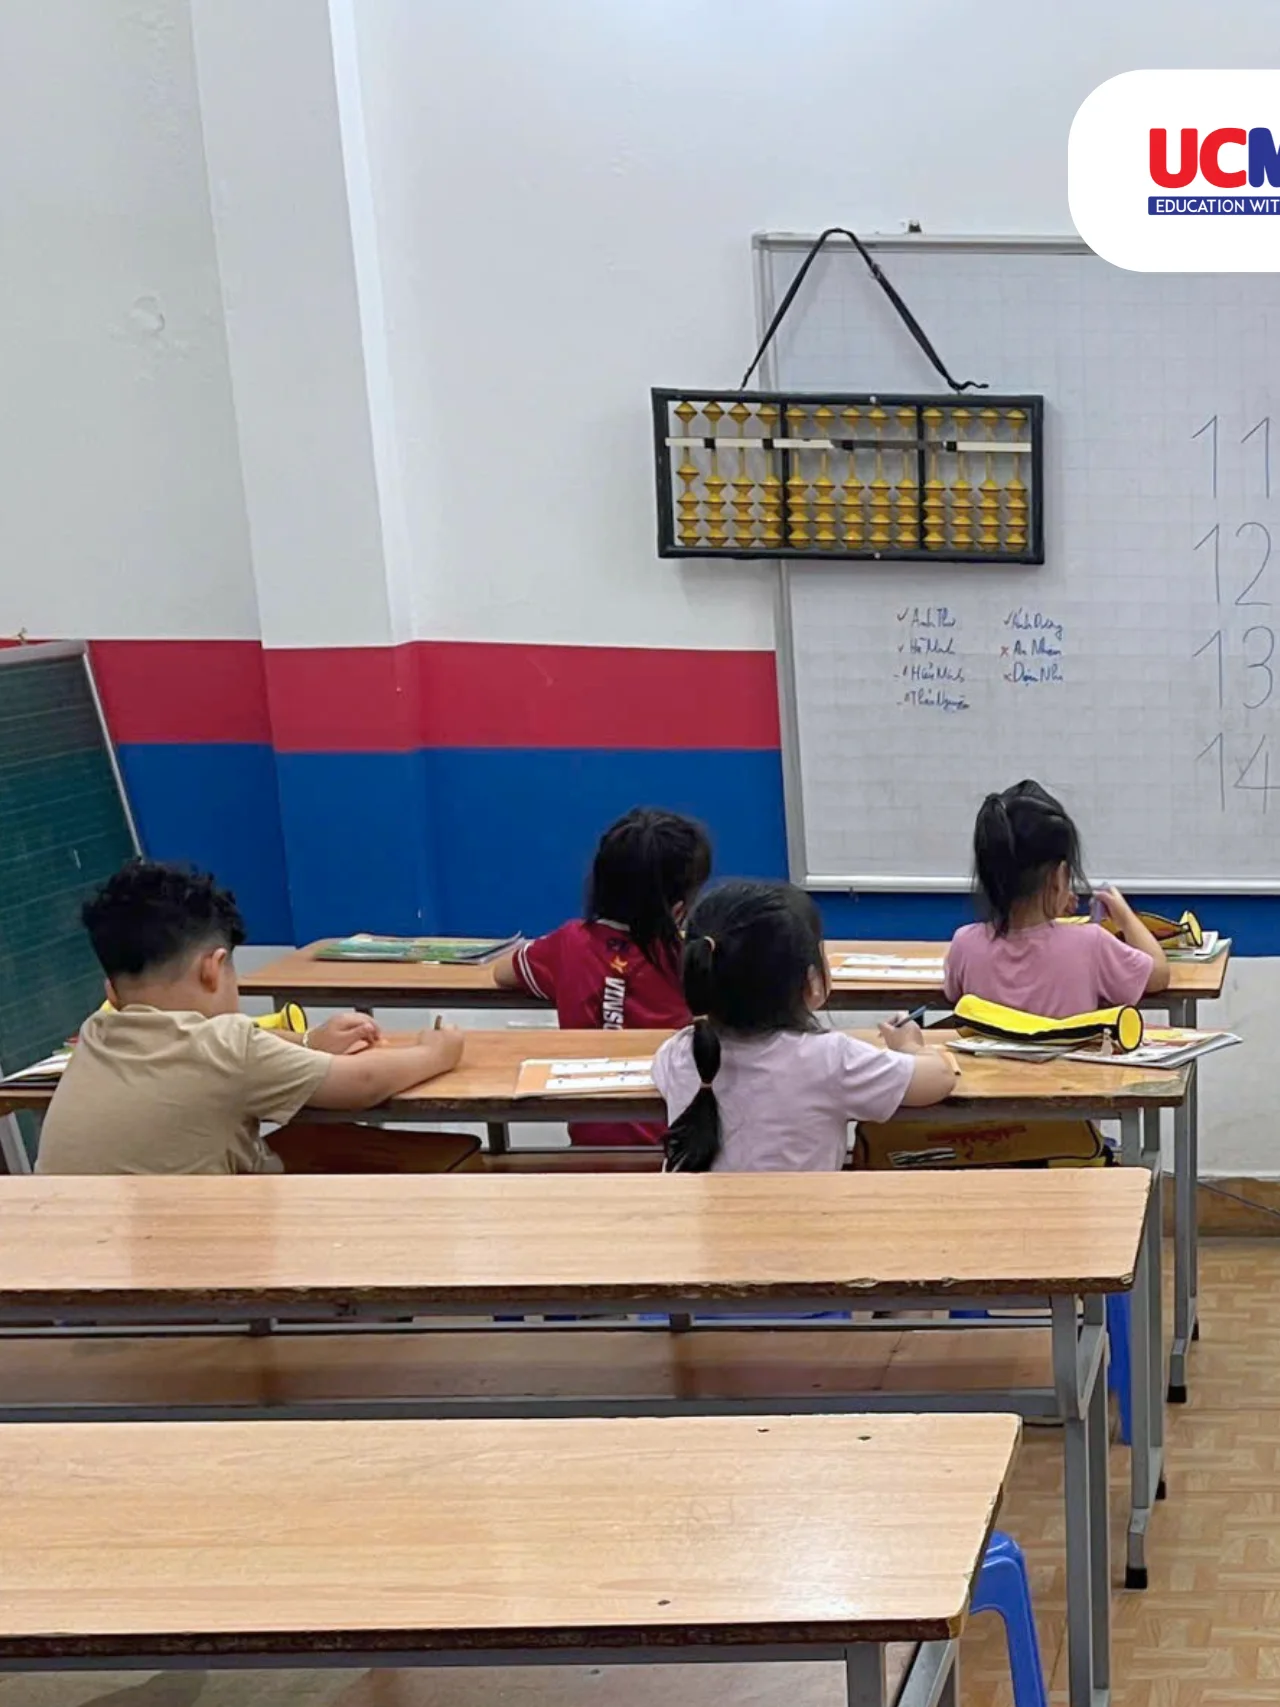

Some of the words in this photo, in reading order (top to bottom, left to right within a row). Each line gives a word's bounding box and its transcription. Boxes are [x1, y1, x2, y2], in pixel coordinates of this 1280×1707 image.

[1190, 414, 1270, 499] 11
[1193, 521, 1273, 607] 12
[1192, 626, 1275, 710] 13
